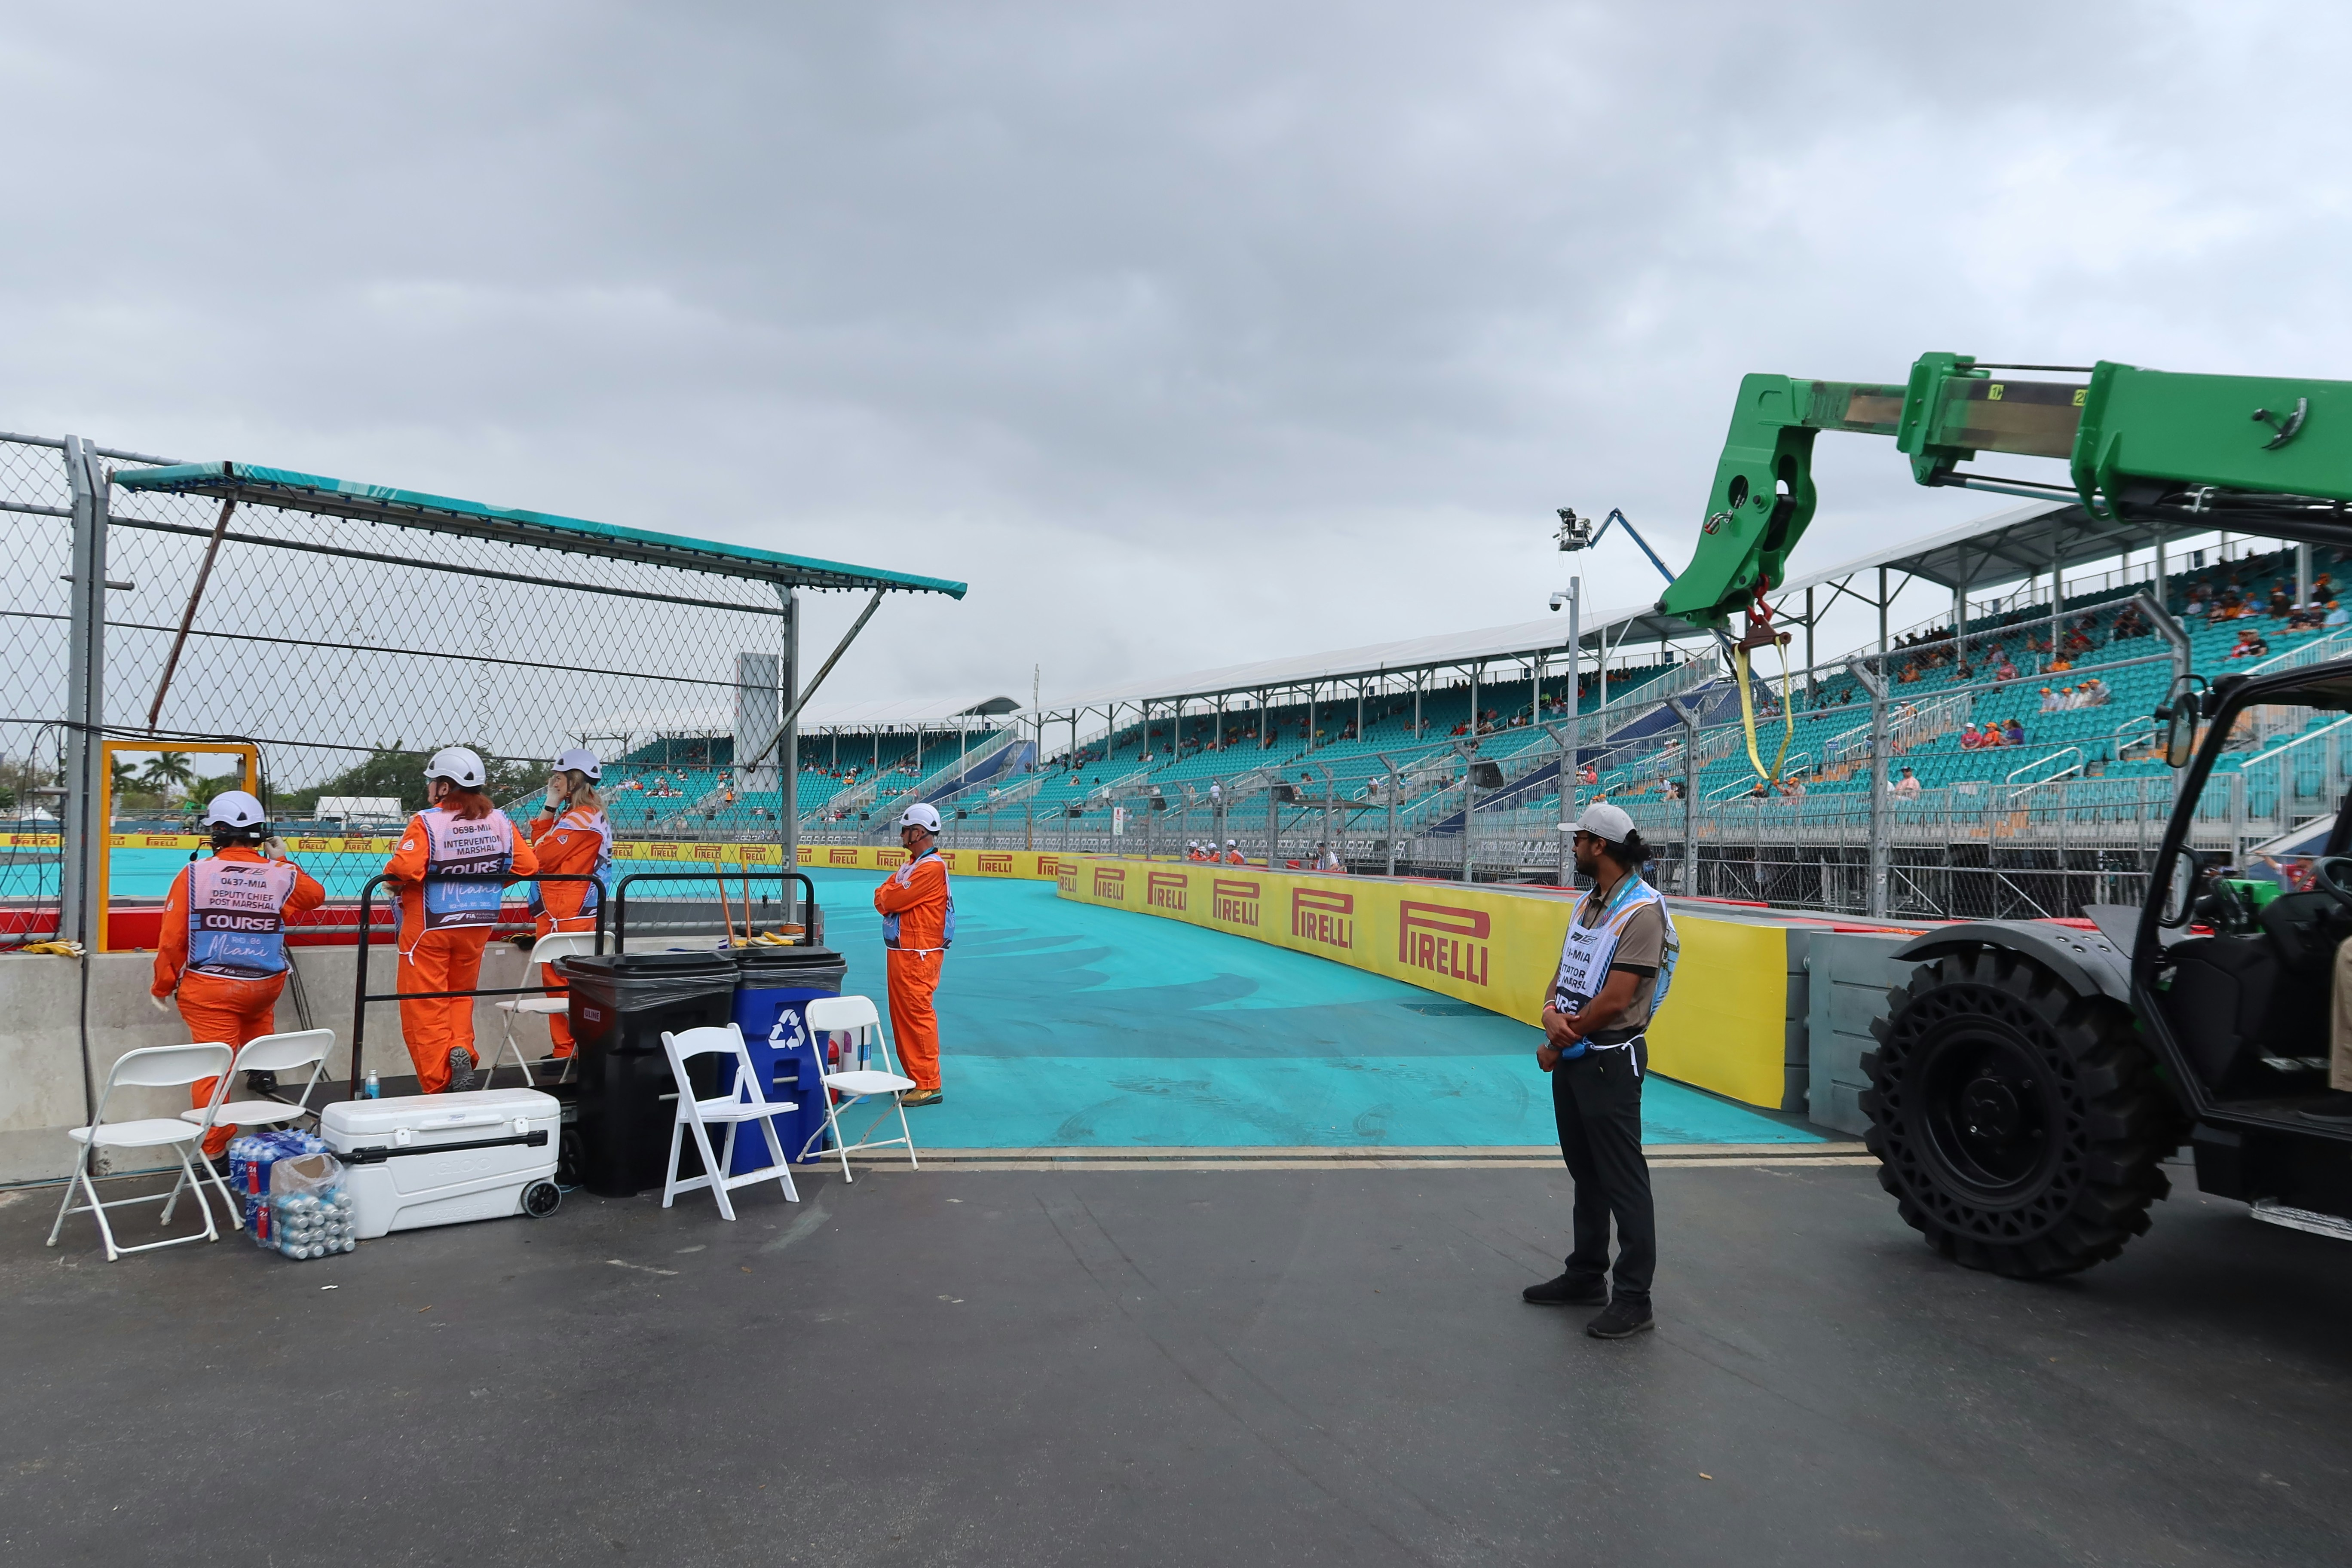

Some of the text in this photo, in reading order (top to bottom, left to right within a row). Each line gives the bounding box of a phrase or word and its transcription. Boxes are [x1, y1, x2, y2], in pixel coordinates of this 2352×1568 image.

[2076, 392, 2085, 403] 2
[146, 837, 178, 846] PIRELLI
[298, 840, 326, 849] PIRELLI
[345, 840, 372, 850] PIRELLI
[444, 835, 502, 848] INTERVENTION
[457, 845, 496, 855] MARSHAL
[651, 845, 677, 857] PIRELLI
[695, 846, 721, 859] PIRELLI
[740, 847, 766, 861] PRELLI
[830, 849, 858, 864] PIRELLI
[978, 854, 1012, 873] PIRELLI
[221, 877, 267, 889] 0437-MIA
[1094, 867, 1125, 901] PIRELLI
[213, 890, 274, 902] DEPUTY CHIEF
[1147, 871, 1188, 911] PIRELLI
[233, 900, 275, 910] MARSHAL
[1213, 878, 1260, 927] PIRELLI
[205, 915, 276, 931] COURSE
[1292, 887, 1354, 949] PIRELLI
[208, 934, 270, 961] Miami
[1399, 900, 1491, 987] PIRELLI
[585, 1010, 599, 1020] ULINE
[920, 1090, 932, 1099] HOKA
[429, 1157, 492, 1176] IGLOO
